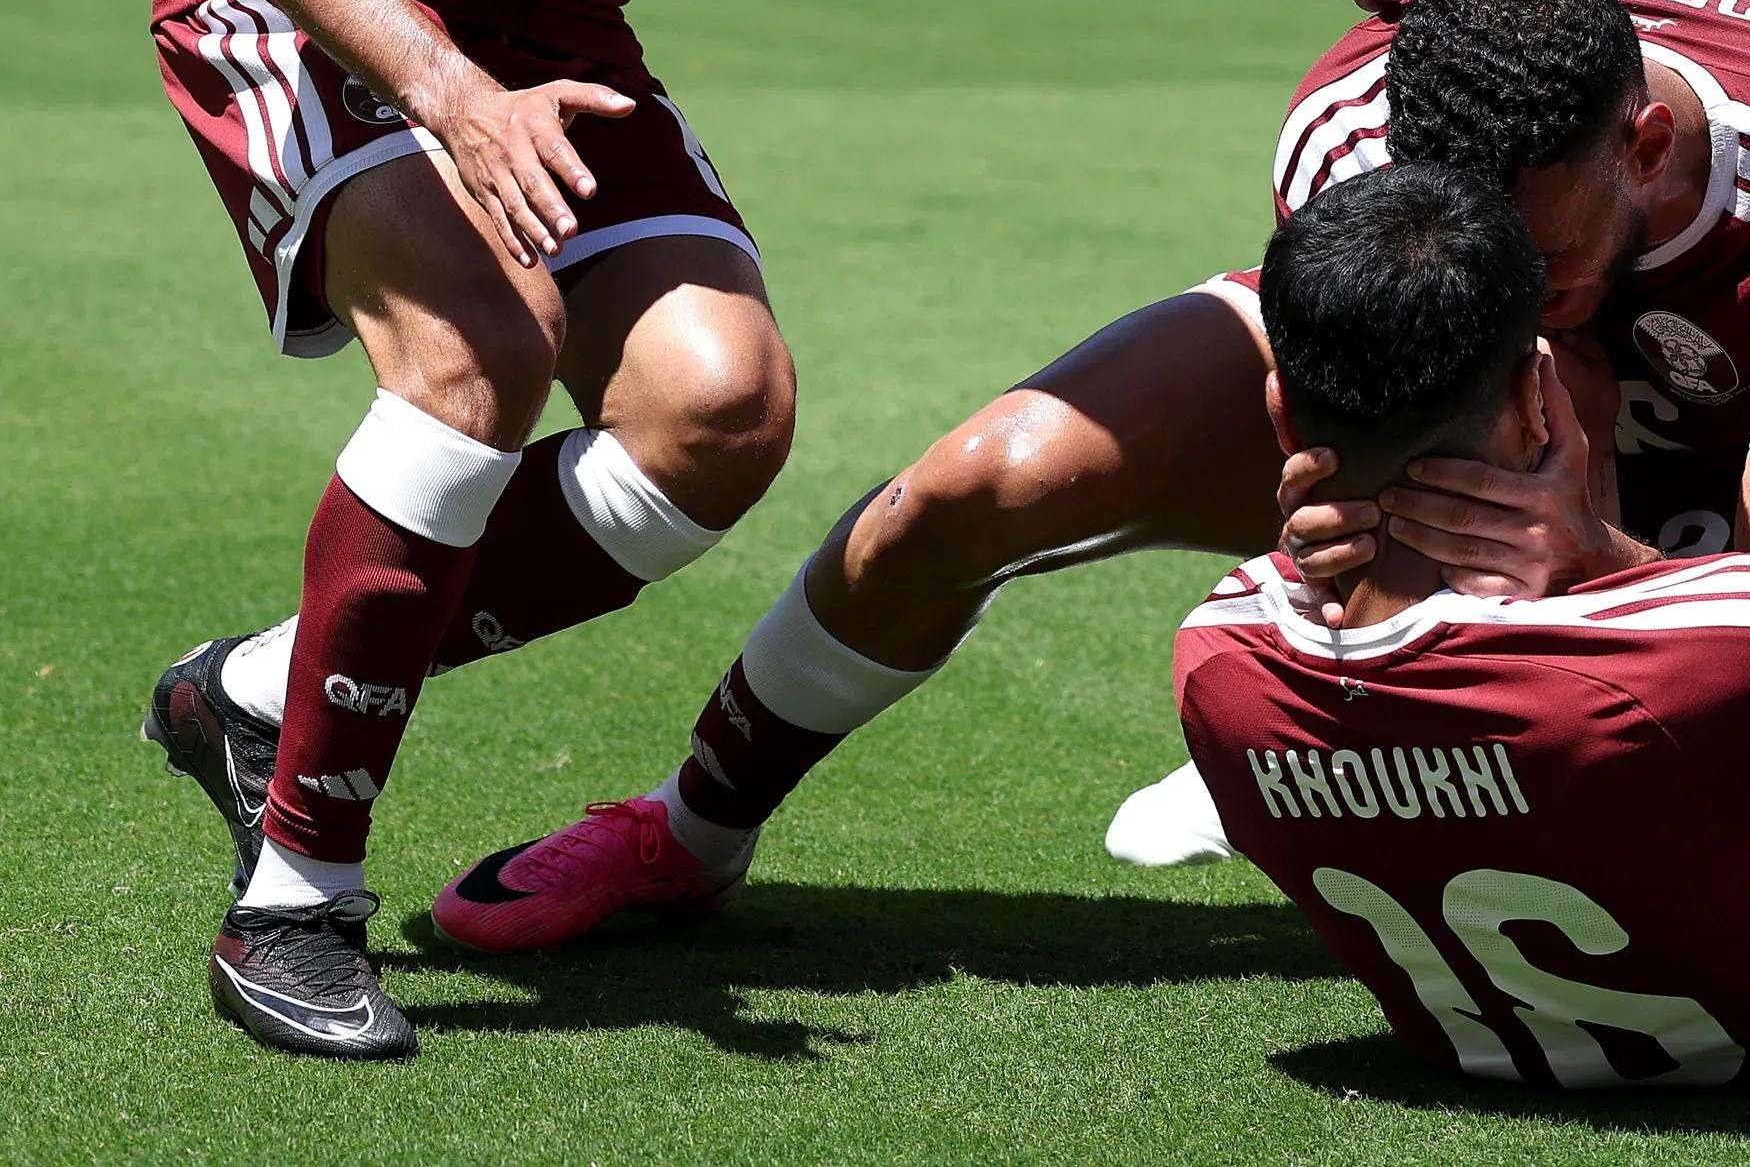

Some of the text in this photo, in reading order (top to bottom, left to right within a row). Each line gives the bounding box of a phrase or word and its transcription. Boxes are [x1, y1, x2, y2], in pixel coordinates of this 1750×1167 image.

[325, 674, 407, 716] QFA
[1247, 743, 1530, 819] KHOUKHI
[1312, 867, 1746, 1090] 16
